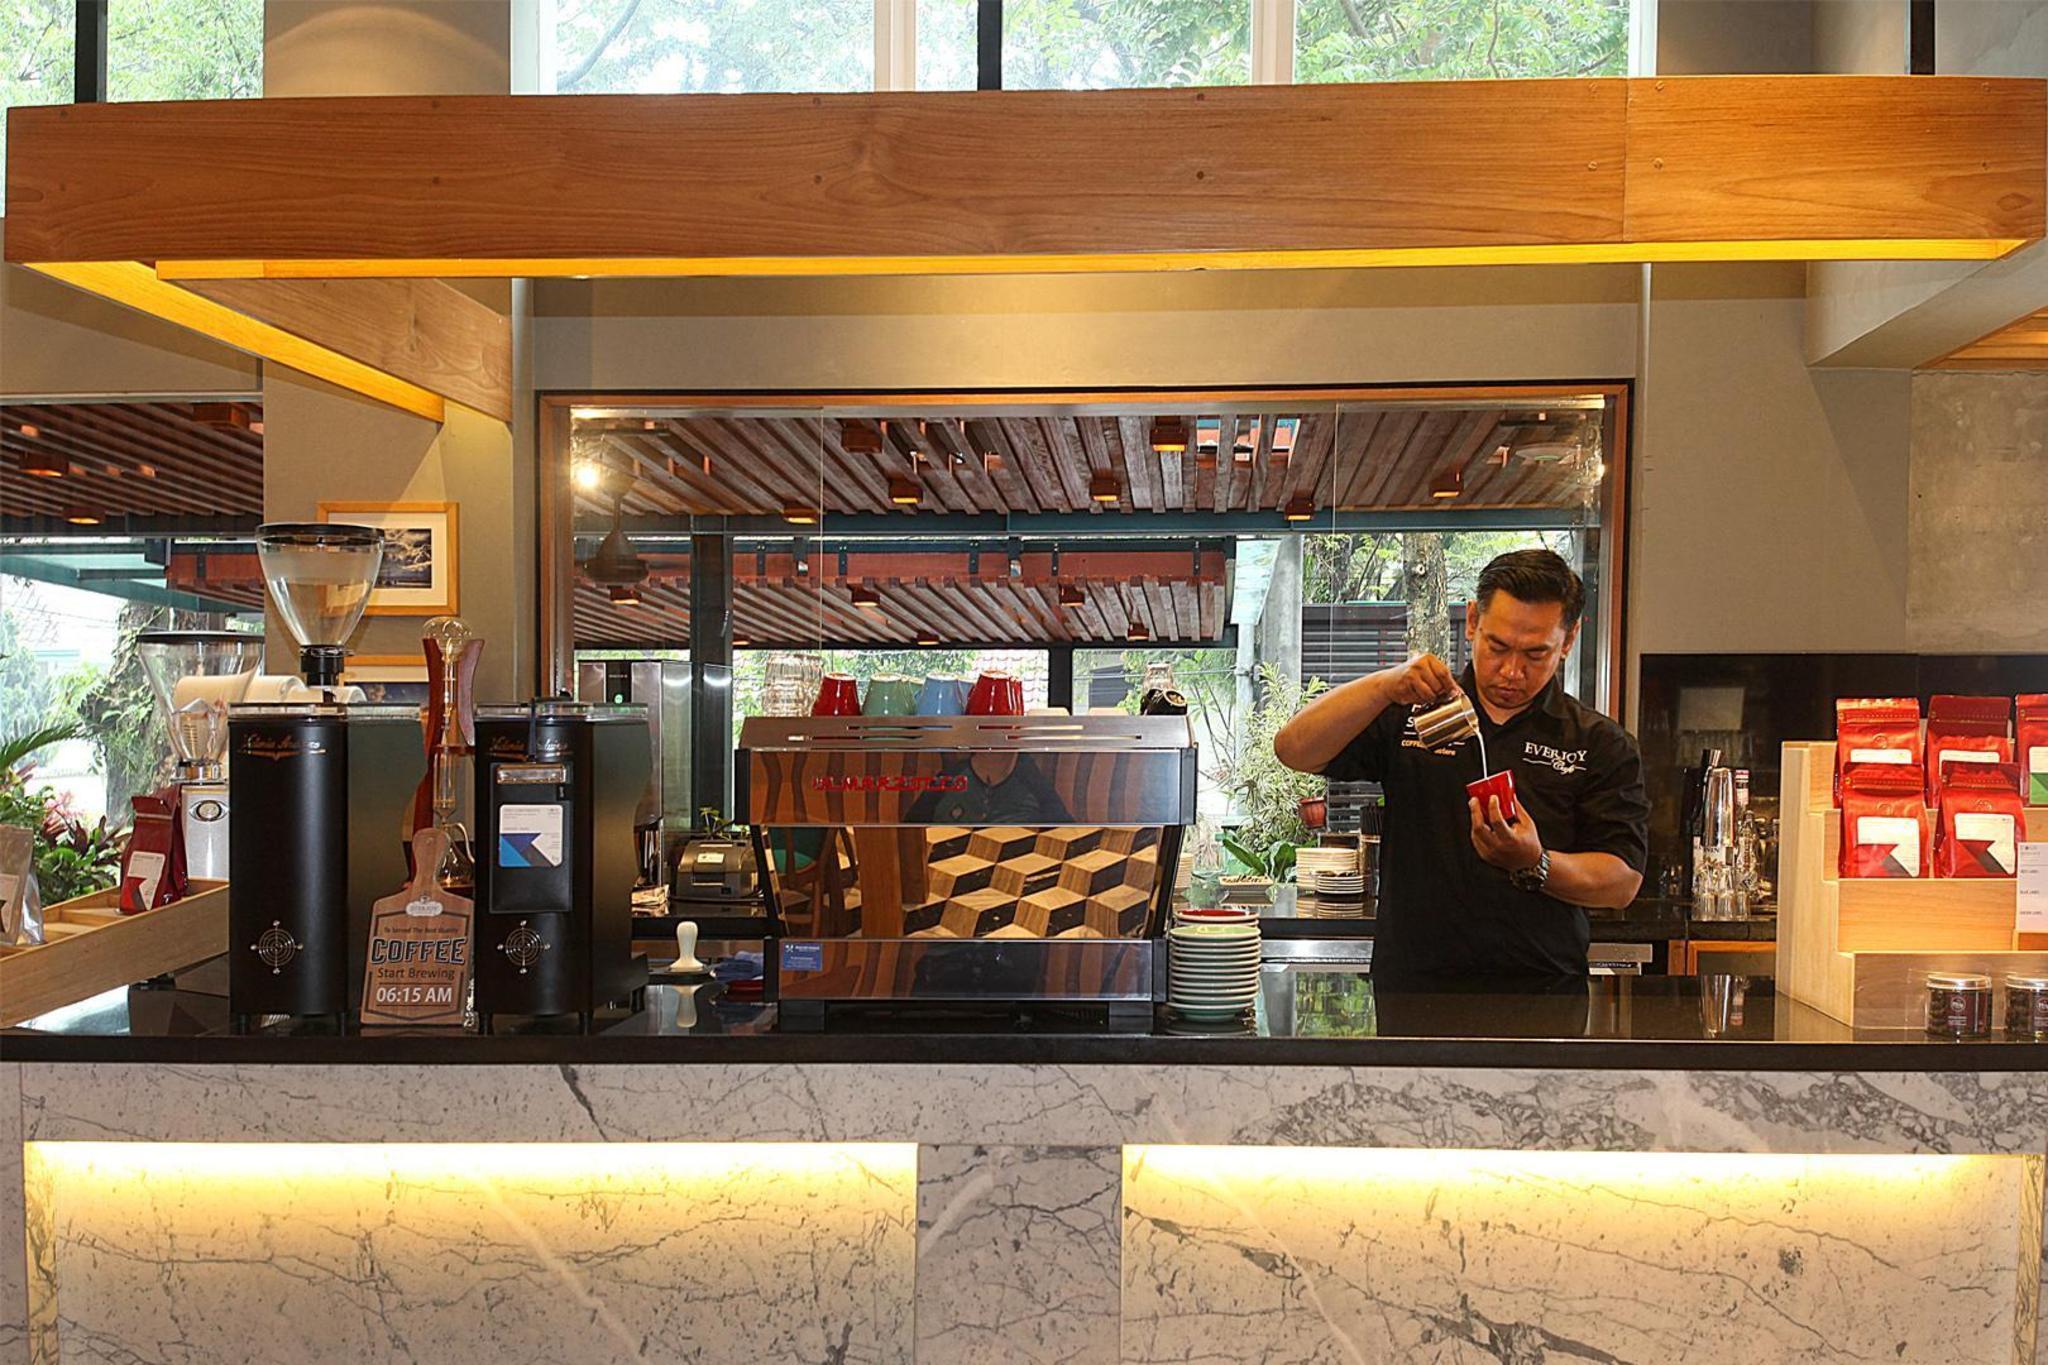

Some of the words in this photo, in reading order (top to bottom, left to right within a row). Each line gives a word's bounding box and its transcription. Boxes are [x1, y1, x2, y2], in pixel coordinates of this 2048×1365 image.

[1524, 741, 1588, 763] EVERJOY
[371, 937, 467, 964] COFFEE
[377, 967, 404, 979] Start
[407, 967, 455, 981] Brewing
[376, 987, 421, 1002] 06:15
[425, 987, 452, 1002] AM
